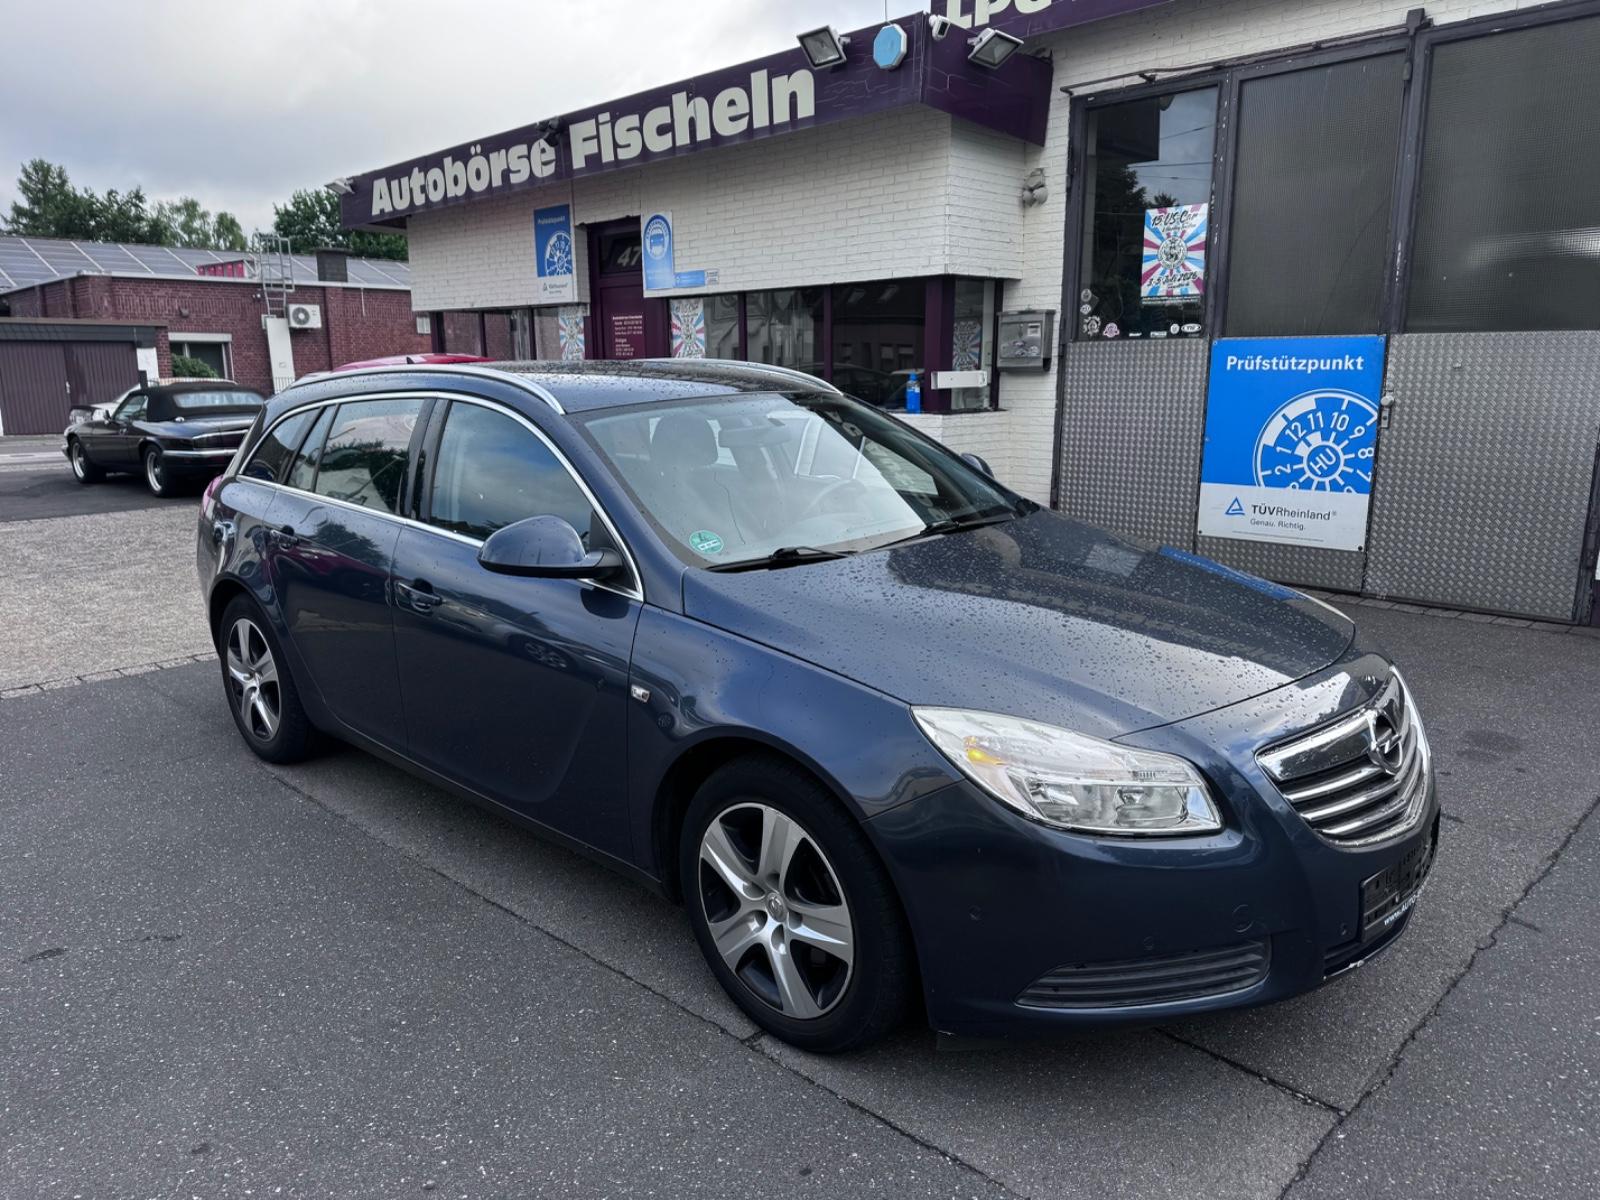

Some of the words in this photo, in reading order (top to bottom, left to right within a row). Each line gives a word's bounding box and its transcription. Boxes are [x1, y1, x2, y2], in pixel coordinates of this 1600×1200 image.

[371, 138, 556, 216] Autobörse
[569, 69, 815, 170] Fischeln
[617, 246, 642, 267] 47
[1226, 355, 1364, 374] Prüfstützpunkt
[1307, 410, 1324, 430] 11
[1330, 411, 1350, 431] 10
[1285, 422, 1307, 441] 12
[1275, 463, 1291, 476] 2
[1309, 448, 1337, 476] HU
[1250, 518, 1276, 528] Genau.
[1278, 520, 1306, 531] Richtig.
